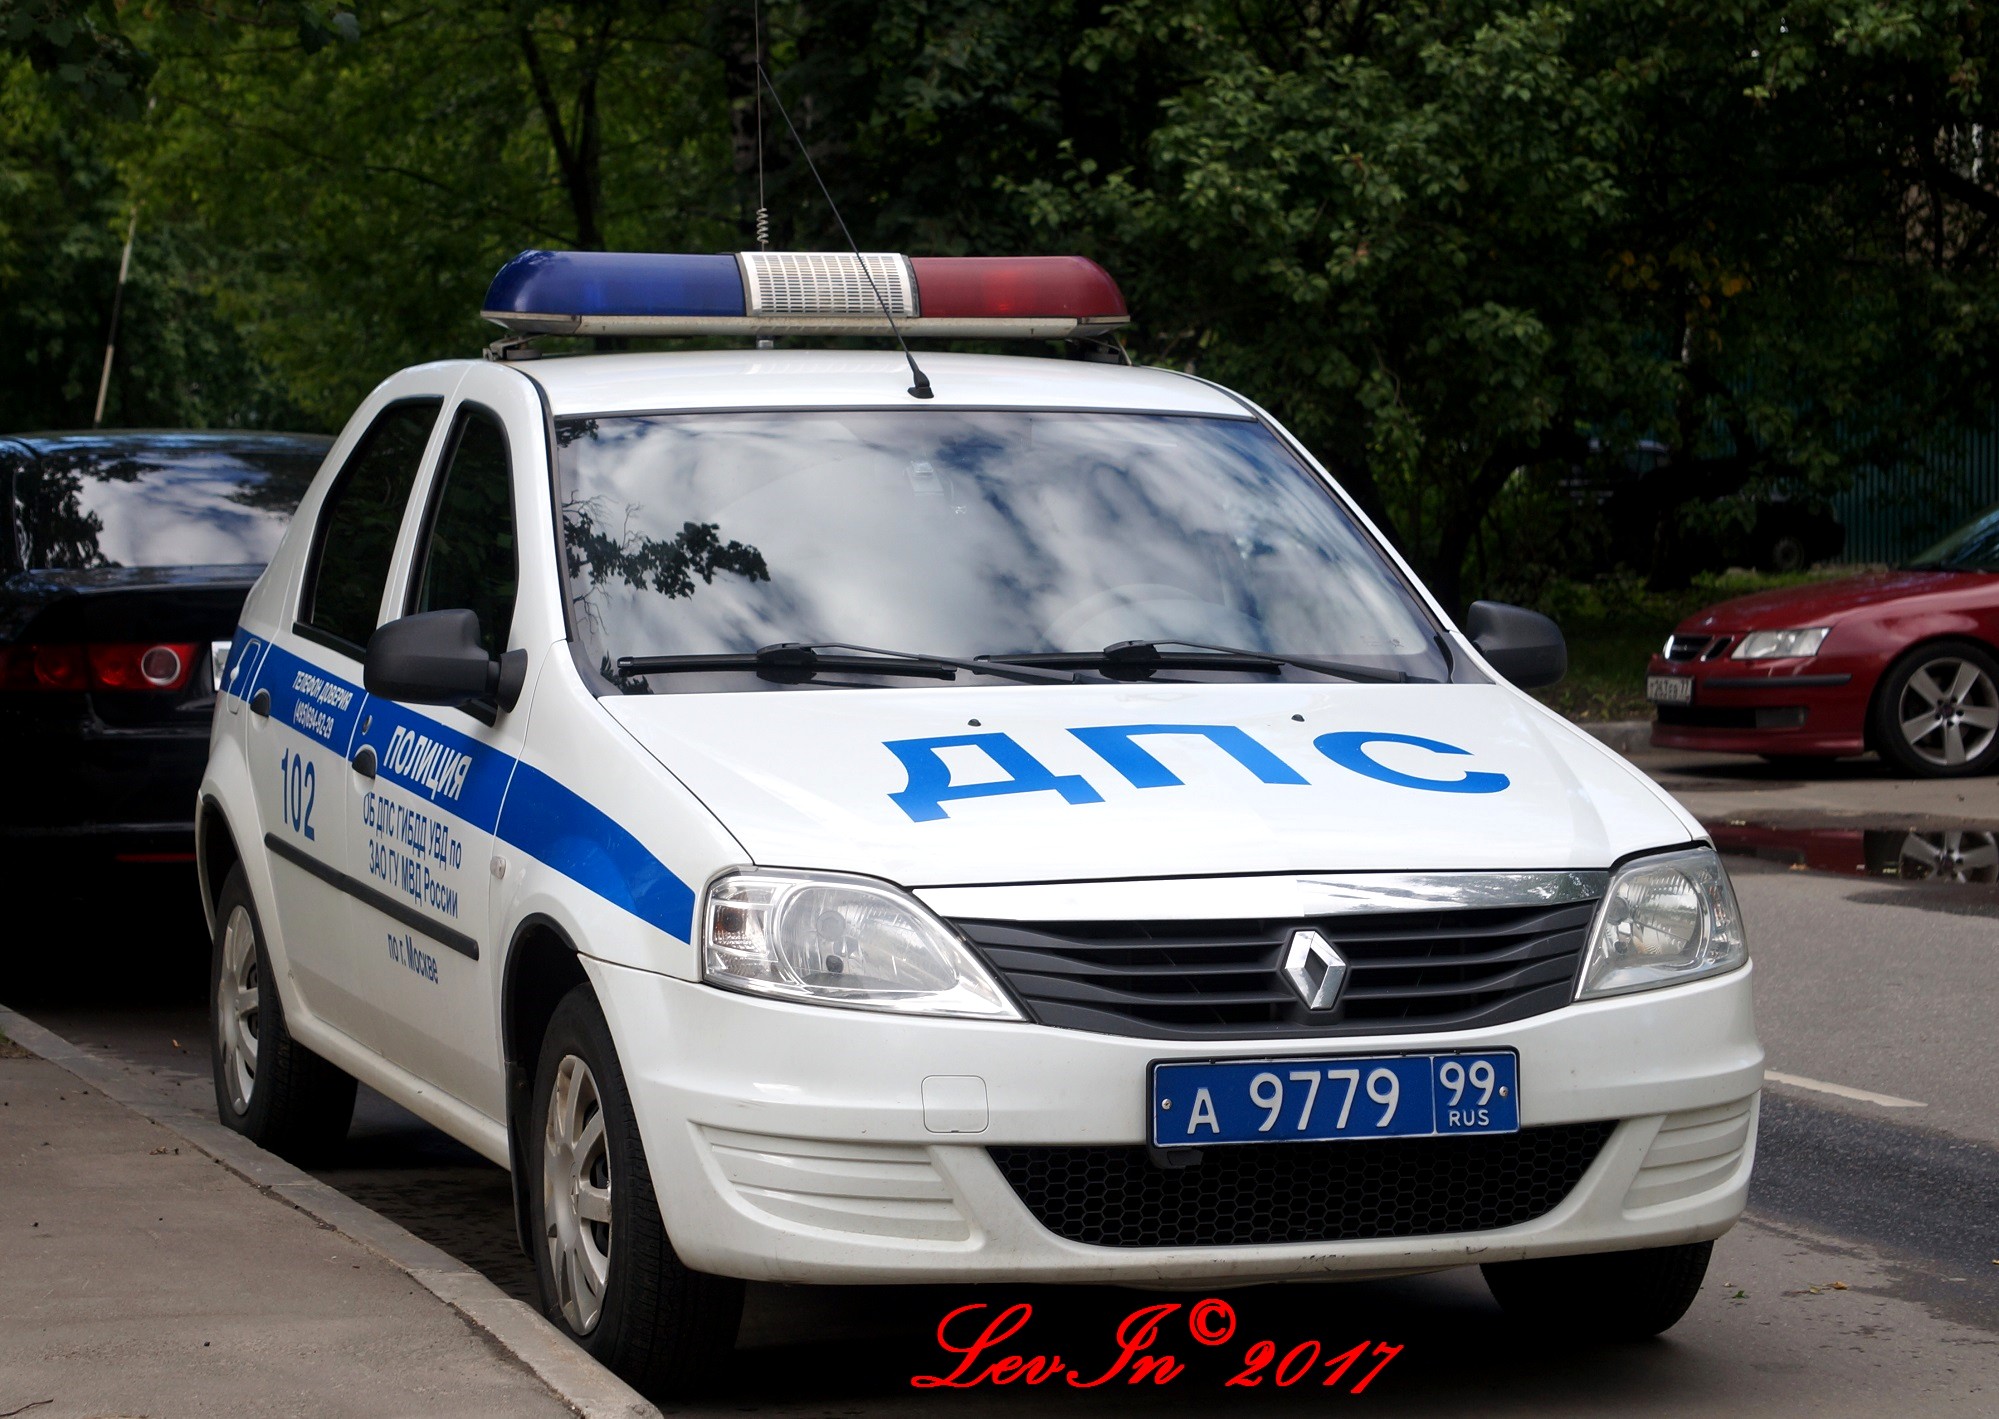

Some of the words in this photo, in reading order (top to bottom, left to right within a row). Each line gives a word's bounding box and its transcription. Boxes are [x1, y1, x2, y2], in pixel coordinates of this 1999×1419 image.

[292, 670, 325, 698] ТЕЛЕФОН
[316, 681, 354, 712] ДОВЕРИЯ
[281, 747, 316, 842] 102
[383, 725, 473, 801] ПОЛИЦИЯ
[881, 723, 1511, 823] ДПС
[363, 791, 376, 827] ОБ
[376, 796, 395, 839] ДПС
[396, 804, 428, 861] ГИБДД
[428, 818, 449, 871] УВД
[369, 838, 387, 880] ЗАО
[389, 848, 400, 887] ГУ
[401, 854, 422, 907] МВД
[387, 933, 399, 962] по
[405, 934, 439, 985] Москве
[1248, 1067, 1400, 1132] 9779
[1438, 1060, 1496, 1107] 99
[1448, 1109, 1491, 1128] RUS
